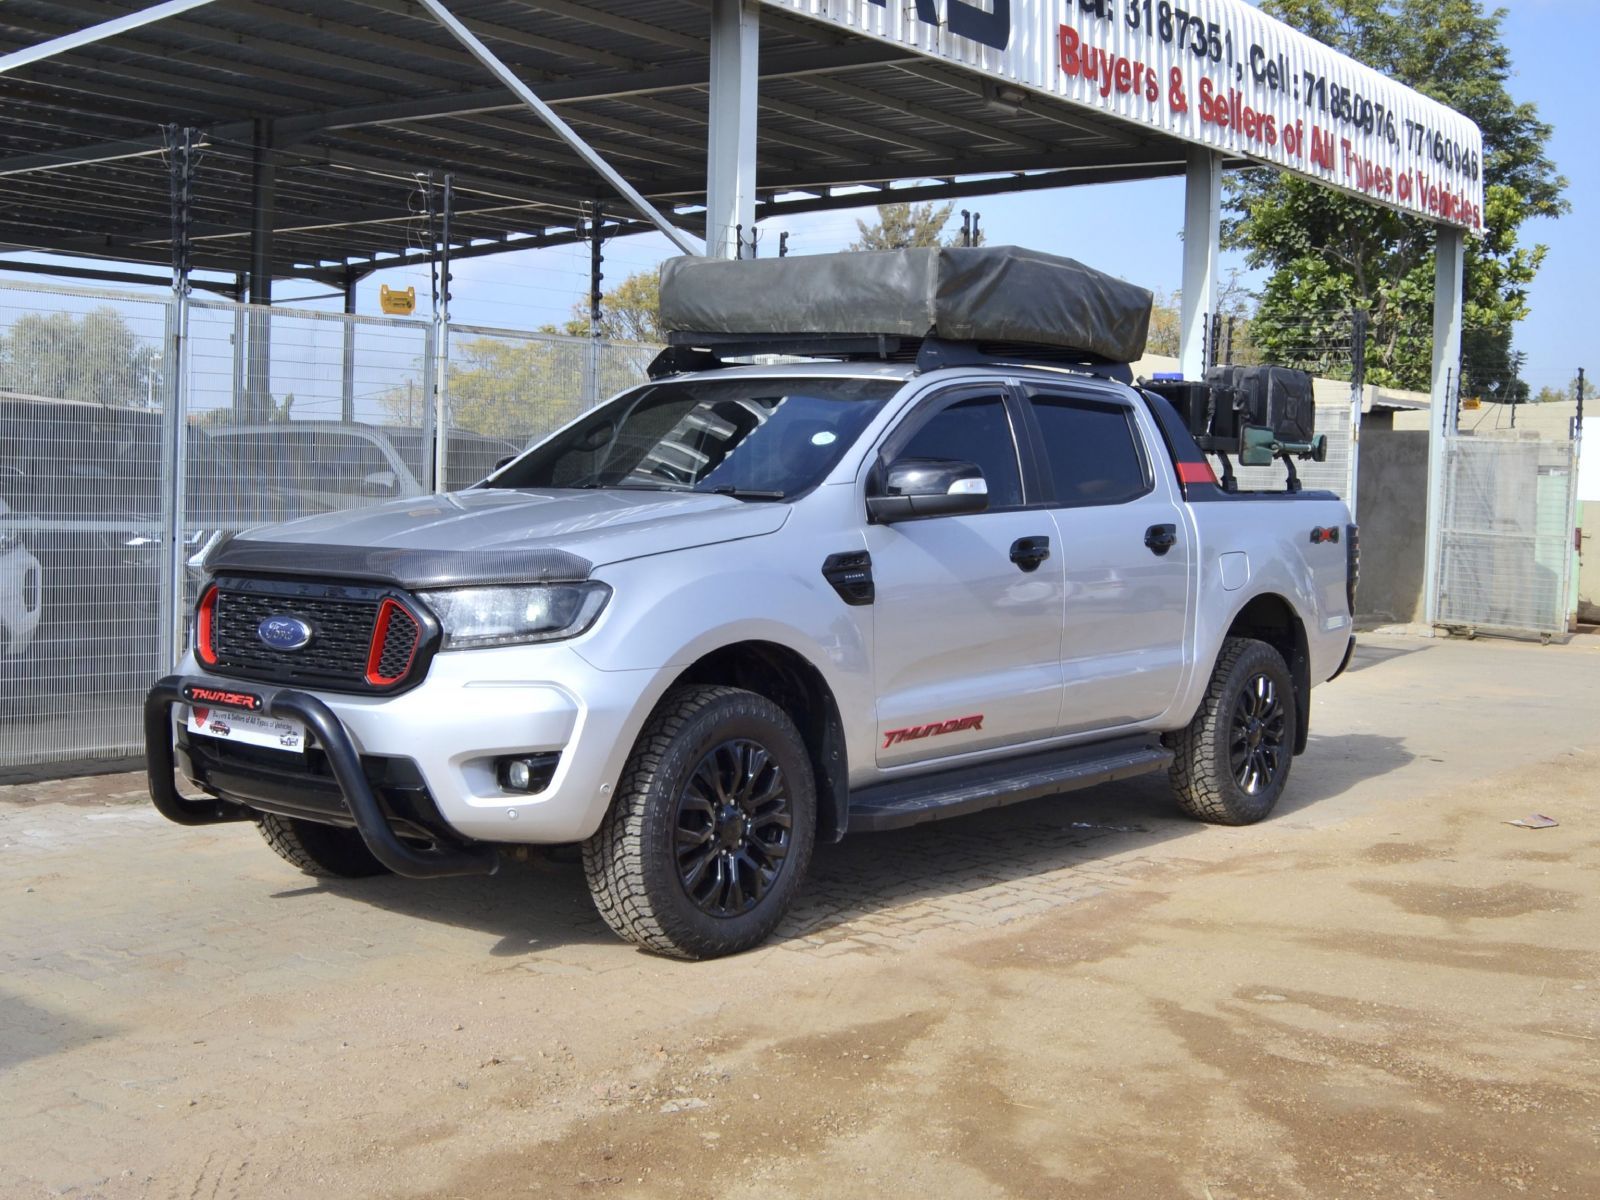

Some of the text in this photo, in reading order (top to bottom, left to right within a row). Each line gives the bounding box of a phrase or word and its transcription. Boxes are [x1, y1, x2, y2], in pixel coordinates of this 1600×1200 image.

[1059, 23, 1159, 103] Buyers
[1168, 66, 1188, 113] &
[1199, 76, 1277, 146] Sellers
[1283, 118, 1304, 159] of
[1310, 125, 1335, 171] All
[1341, 137, 1393, 195] Types
[1398, 167, 1413, 201] of
[1418, 171, 1481, 229] Vehicles
[1405, 118, 1479, 182] 77160946
[191, 688, 255, 710] THUNDER
[882, 714, 984, 749] THUNDER
